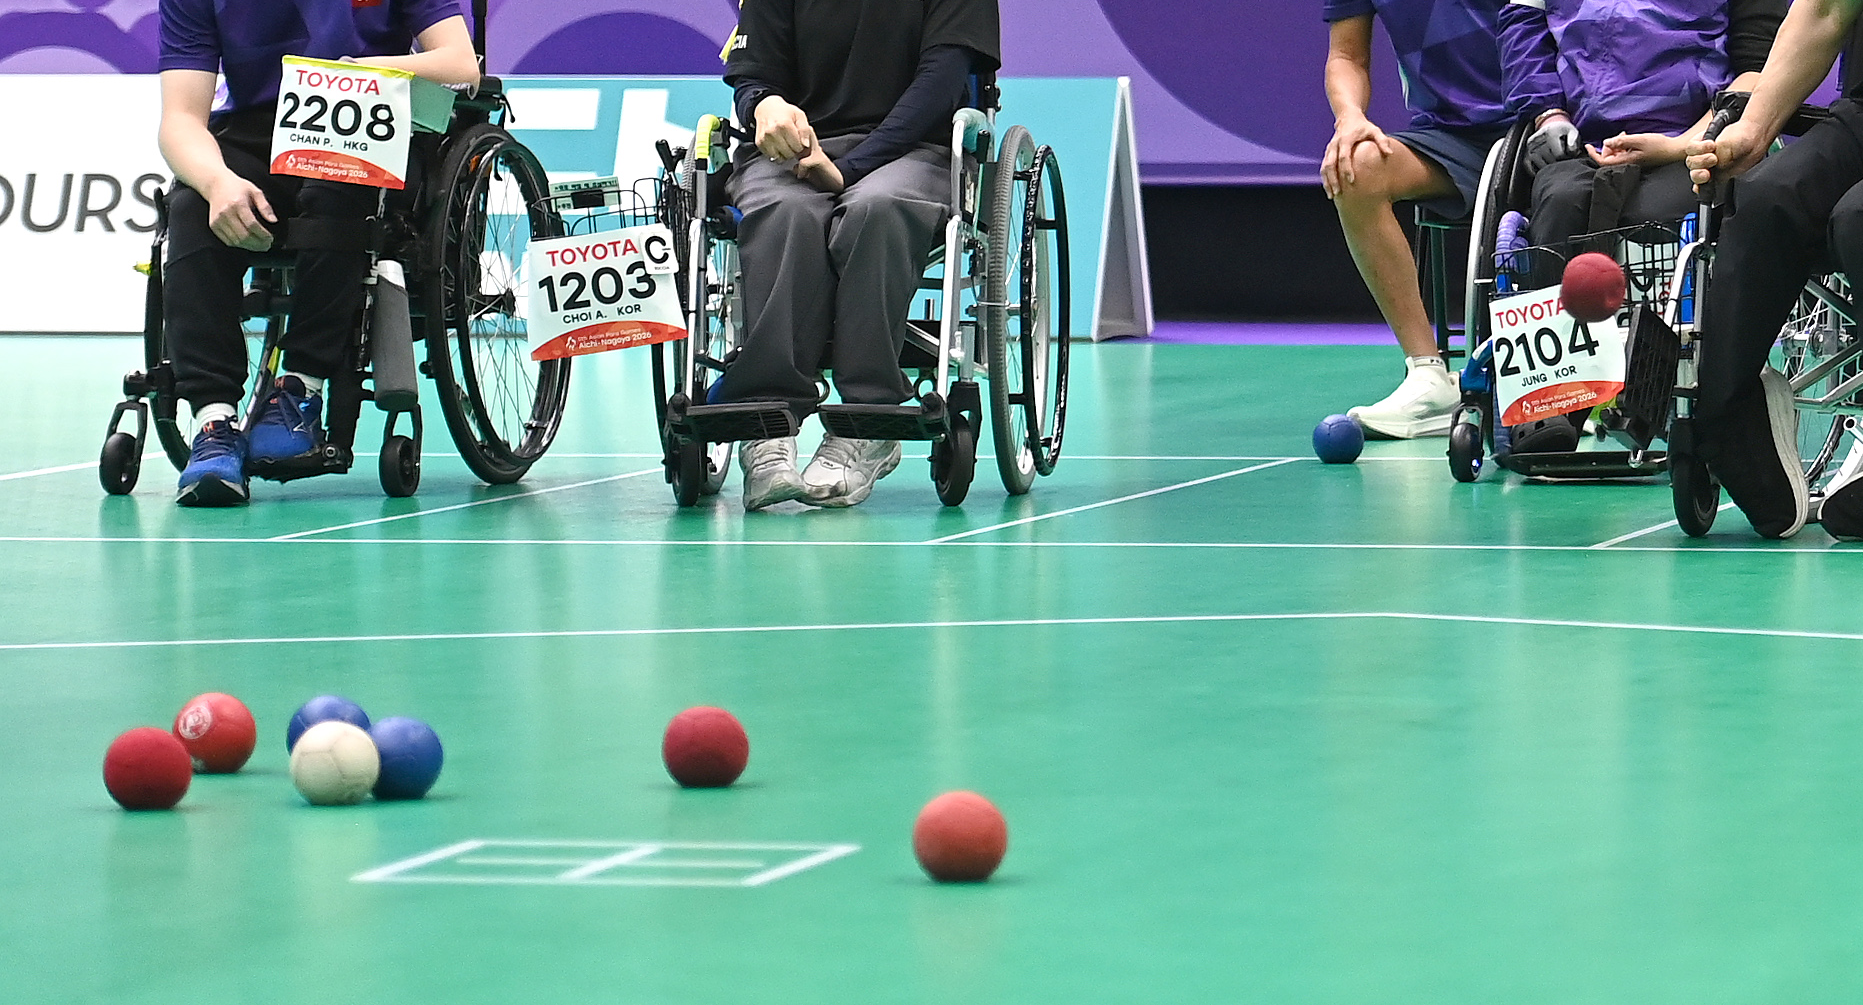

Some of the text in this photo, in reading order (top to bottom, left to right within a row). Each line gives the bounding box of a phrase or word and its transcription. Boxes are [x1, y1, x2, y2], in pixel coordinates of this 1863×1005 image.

[295, 69, 380, 95] TOYOTA
[279, 91, 395, 142] 2208
[289, 133, 368, 151] CHAN P. HKG
[296, 162, 368, 178] Aichi-Nagoya 2026
[0, 172, 166, 233] URS
[546, 239, 638, 267] TOYOTA
[645, 235, 669, 264] C
[538, 261, 657, 313] 1203
[563, 303, 642, 324] CHOI A. KOR
[579, 331, 651, 349] Aichi-Nagoya 2026
[1495, 319, 1600, 378] 2104
[1521, 365, 1577, 387] JUNG KOR
[1578, 391, 1597, 404] 2026
